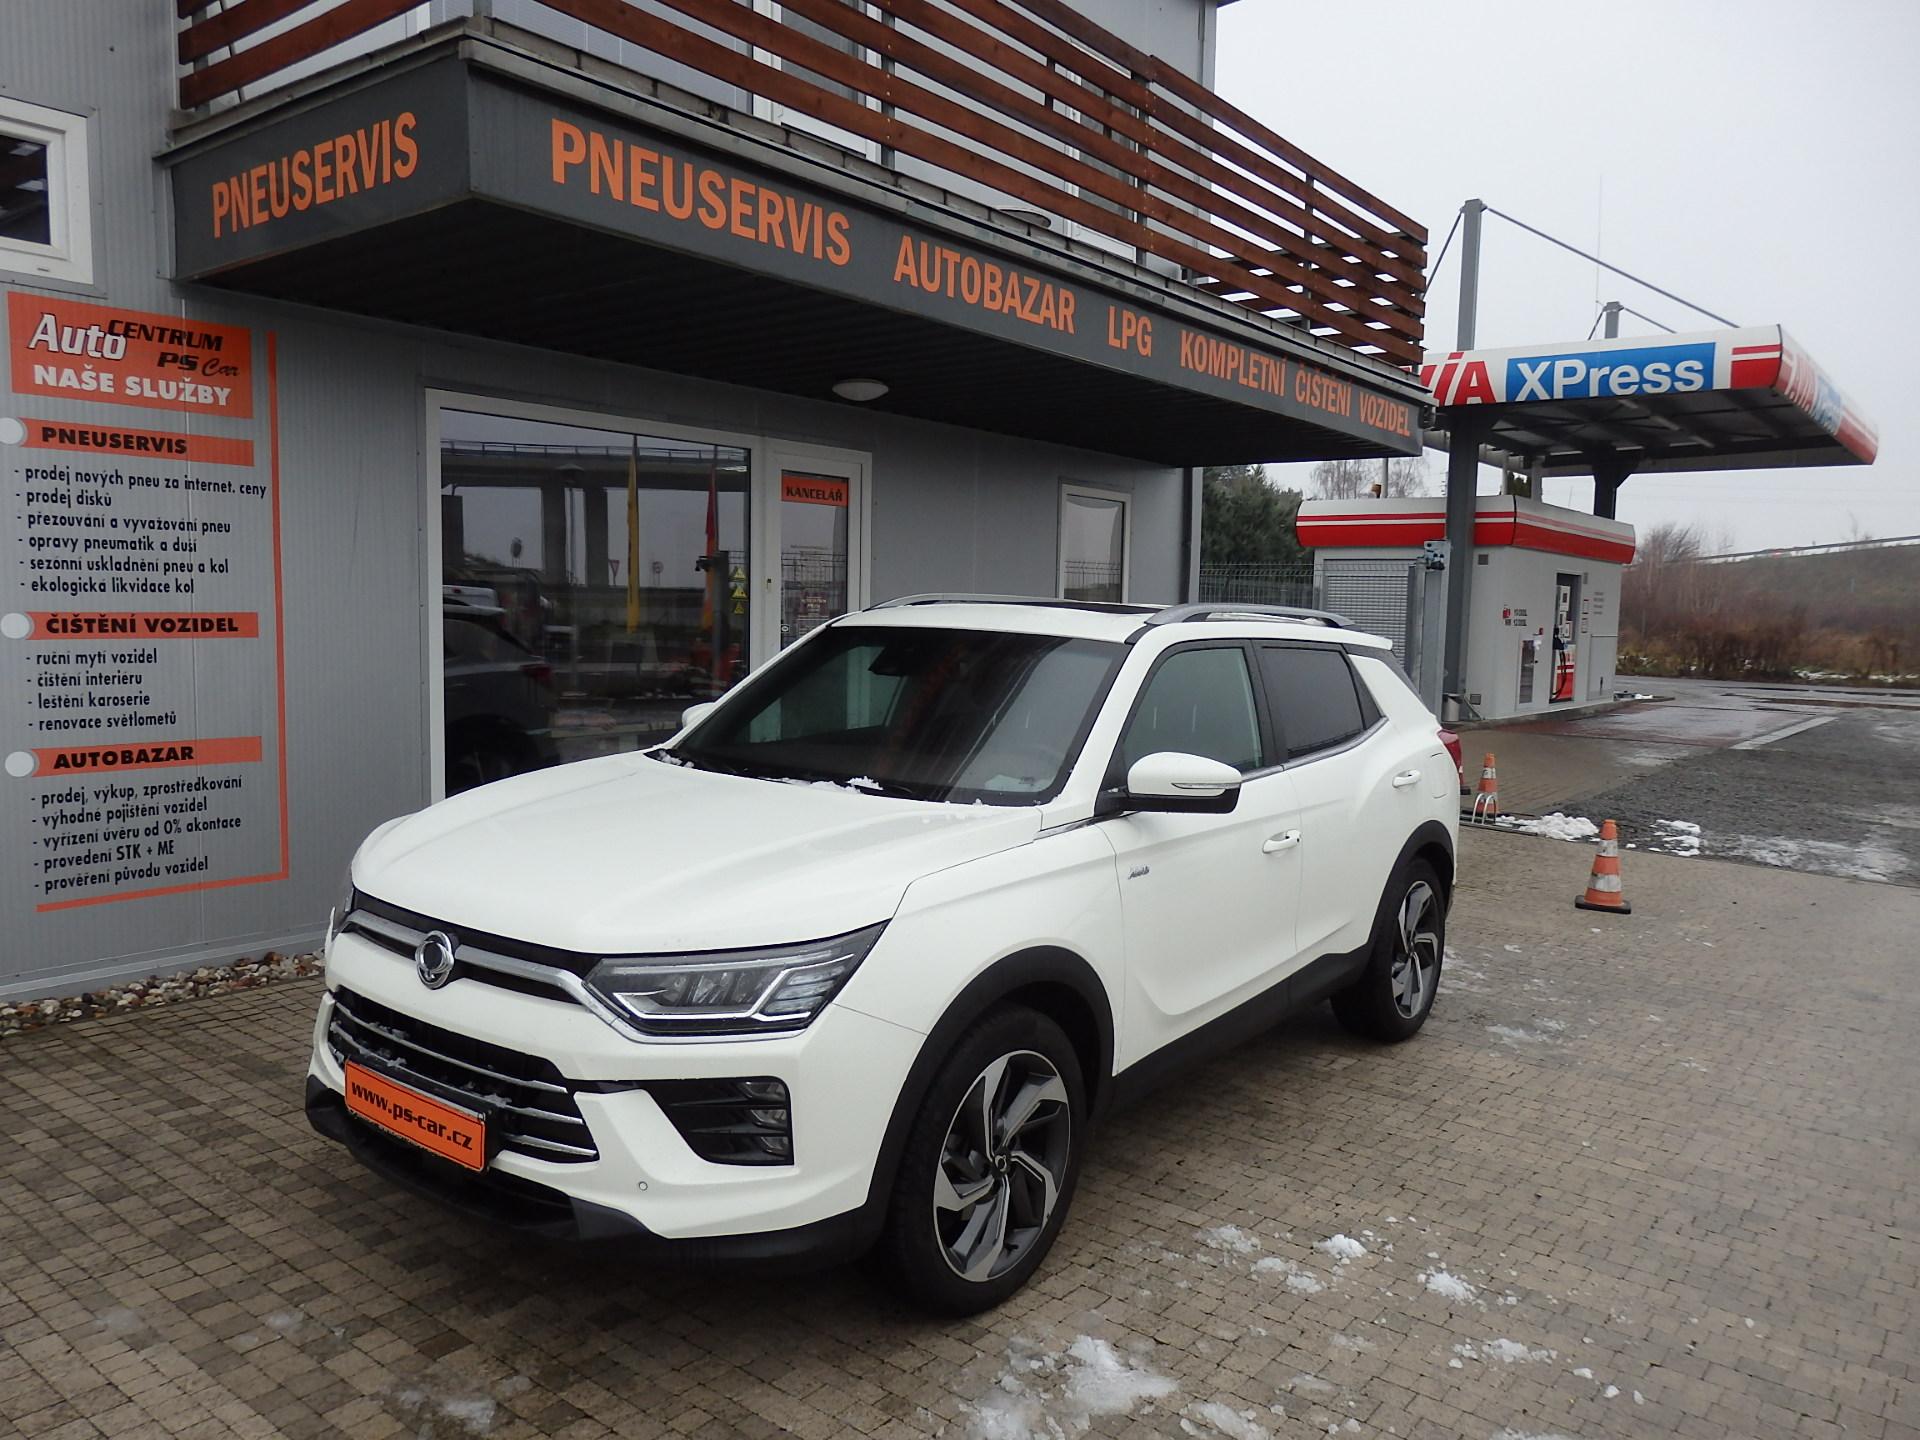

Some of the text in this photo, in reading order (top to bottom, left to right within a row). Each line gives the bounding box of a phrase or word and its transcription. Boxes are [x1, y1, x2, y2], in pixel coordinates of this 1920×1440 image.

[212, 111, 419, 238] PNEUSERVIS
[551, 118, 1411, 437] PNEUSERVIS AUTOBAZAR LPG KOMPLETNÍ ČIŠTĚNÍ VOZIDEL
[27, 312, 224, 361] Auto CENTRUM
[157, 351, 241, 377] PS Car
[33, 363, 231, 406] NAŠE SLUŽBY
[1513, 359, 1704, 401] XPress
[42, 426, 188, 454] PNEUSERVIS
[25, 464, 267, 499] prodej nových pneu za internet. ceny
[786, 486, 843, 502] KANCELÁŘ
[26, 487, 112, 508] prodej disků
[28, 511, 231, 536] přezouvání a vyvažování pneu
[29, 535, 197, 553] opravy pneumatik a duší
[30, 555, 229, 576] sezónní uskladnění pneu a kol
[31, 575, 194, 596] ekologická likvidace kol
[46, 613, 239, 634] ČIŠTĚNÍ VOZIDEL
[36, 648, 158, 668] ruční mytí vozidel
[37, 670, 142, 687] čištění interiéru
[38, 690, 151, 709] leštění karoserie
[39, 711, 177, 731] renovace světlometů
[54, 746, 195, 770] AUTOBAZAR
[41, 775, 242, 809] prodej, výkup, zprostředkování
[42, 796, 208, 830] výhodné pojištění vozidel
[43, 817, 241, 851] vyřízení úvěru od 0% akontace
[44, 839, 175, 874] provedení STK + ME
[45, 855, 208, 895] prověření původu vozidel
[351, 1081, 473, 1151] www.ps-car.cz
